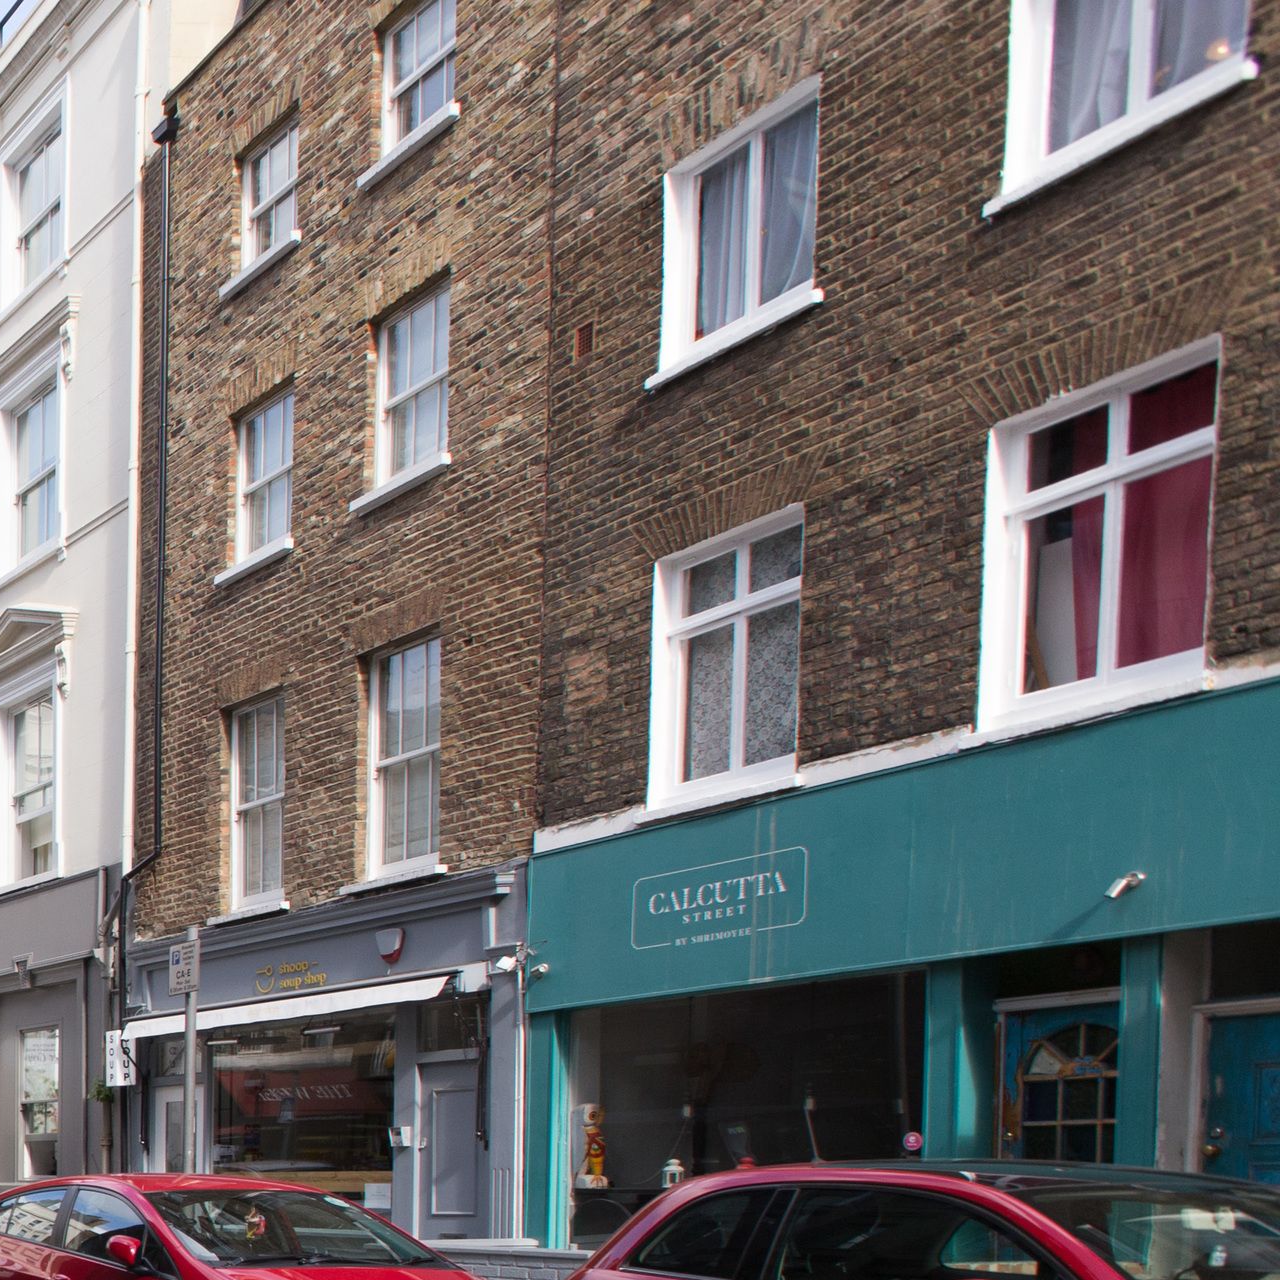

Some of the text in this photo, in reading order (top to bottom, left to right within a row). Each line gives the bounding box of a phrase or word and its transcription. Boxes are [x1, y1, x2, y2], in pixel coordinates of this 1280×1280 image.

[648, 871, 787, 915] CALCUTTA
[681, 904, 747, 924] STREET
[674, 938, 688, 946] BY
[175, 968, 191, 980] CA-E
[279, 961, 309, 974] shoop
[280, 971, 327, 989] soup shop
